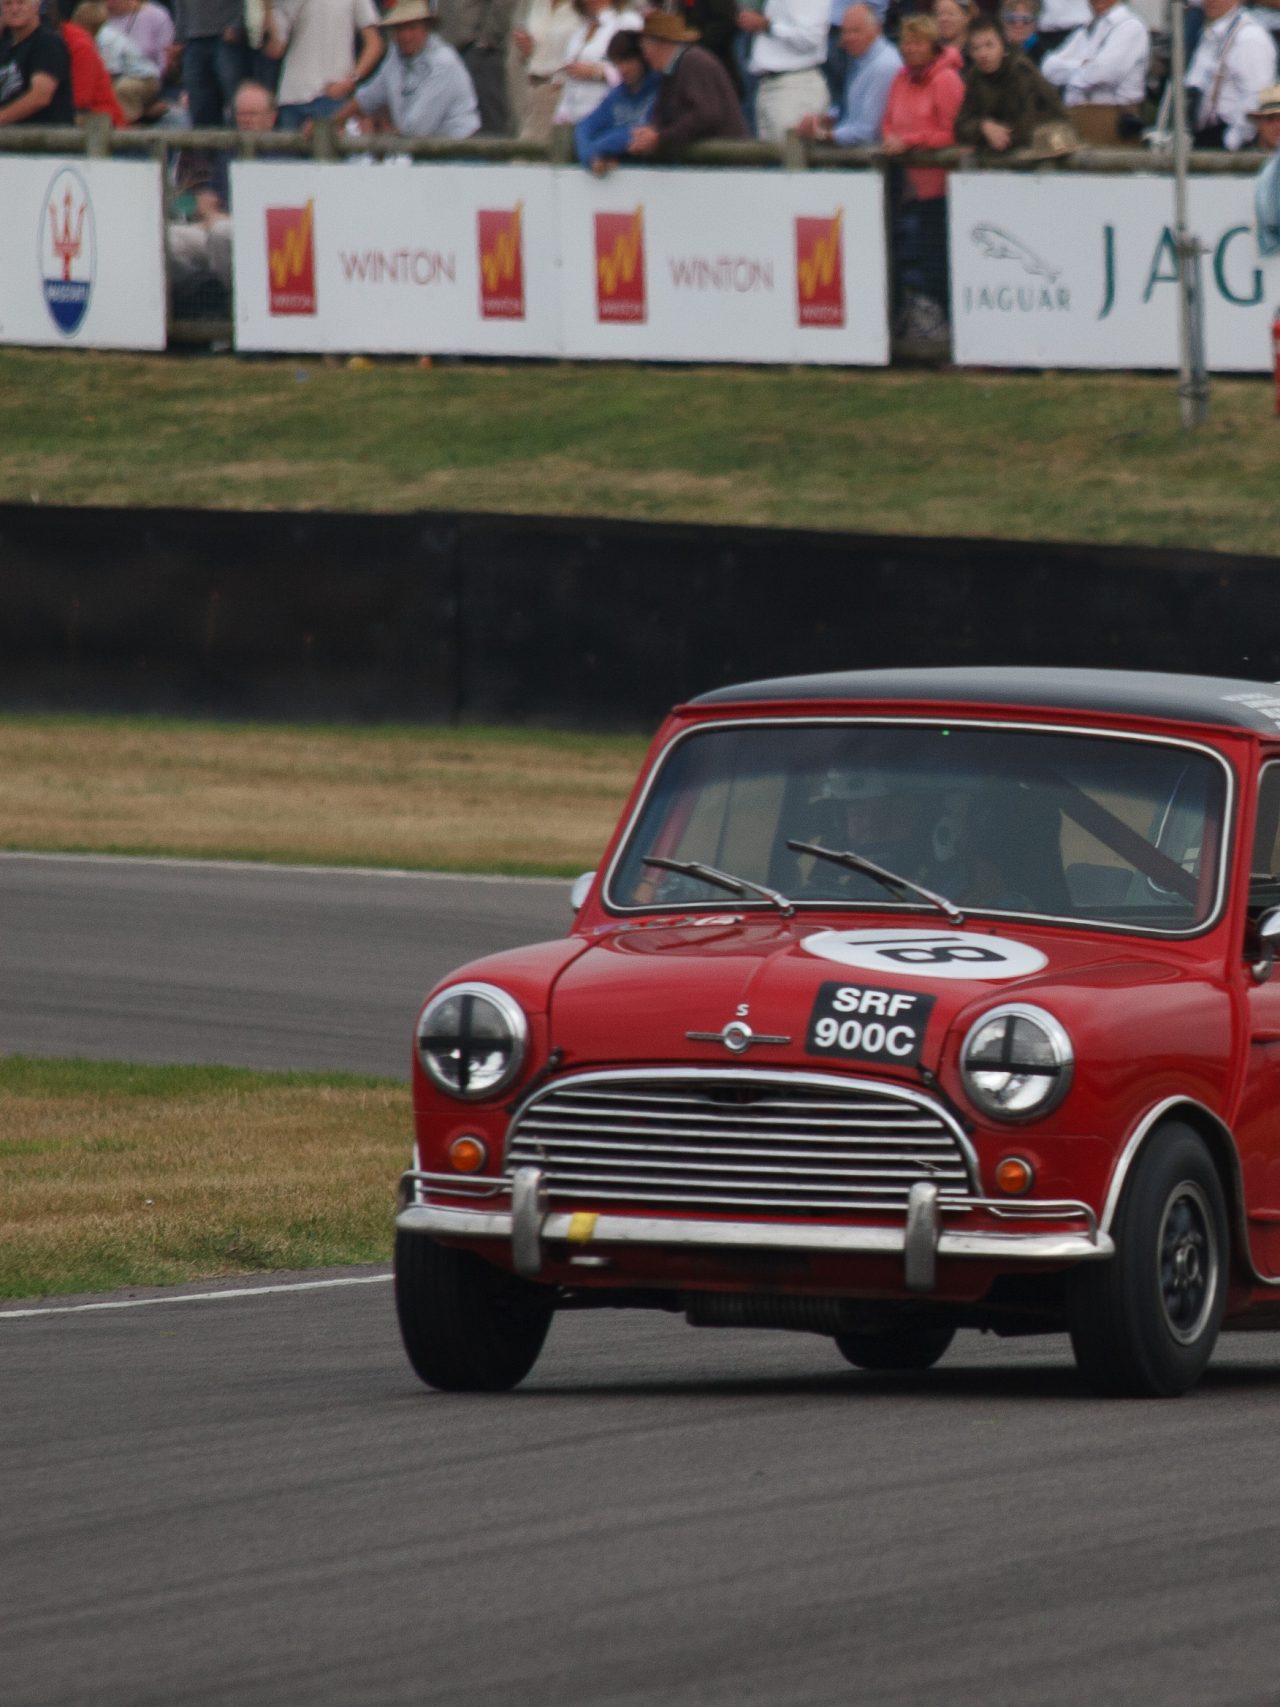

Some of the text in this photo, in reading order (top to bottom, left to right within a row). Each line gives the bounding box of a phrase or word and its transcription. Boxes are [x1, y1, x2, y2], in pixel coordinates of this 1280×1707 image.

[338, 251, 456, 285] WINTON
[669, 256, 774, 292] WINTON
[962, 286, 1071, 313] JAGUAR
[846, 937, 1008, 964] 18
[735, 1003, 750, 1016] S
[832, 987, 917, 1017] SRF
[814, 1017, 916, 1056] 900C
